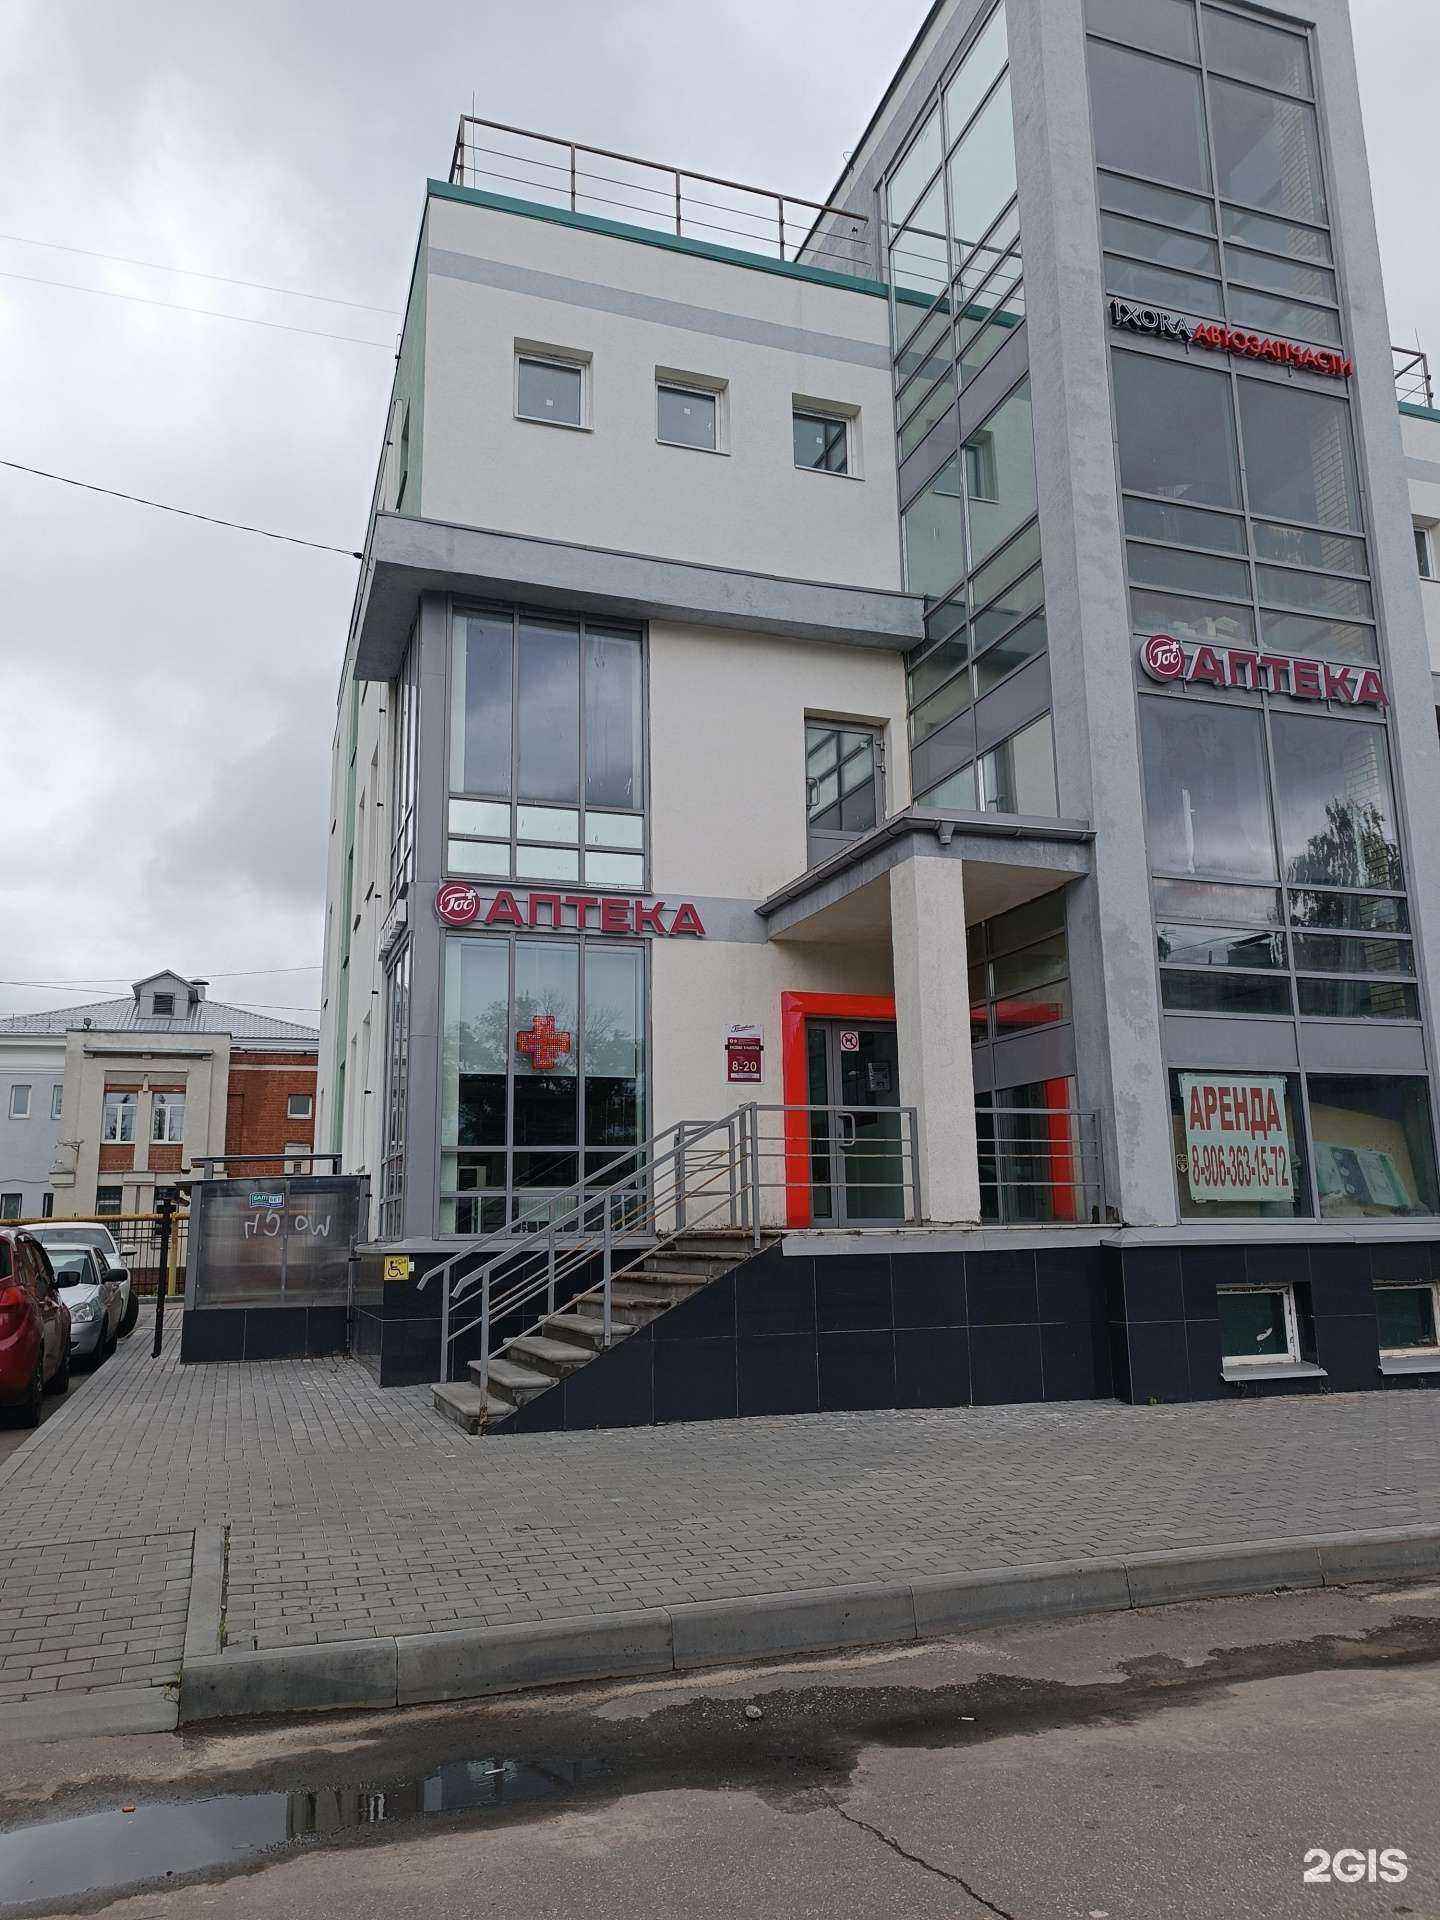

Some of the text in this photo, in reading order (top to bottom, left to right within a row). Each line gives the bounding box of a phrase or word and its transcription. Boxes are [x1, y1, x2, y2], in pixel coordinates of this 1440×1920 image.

[1185, 646, 1390, 706] АПТЕКА
[484, 890, 706, 937] АПТЕКА
[731, 1061, 757, 1072] 8-20
[1189, 1086, 1282, 1140] АРЕНДА
[1191, 1145, 1290, 1187] 8-906-363-15-72
